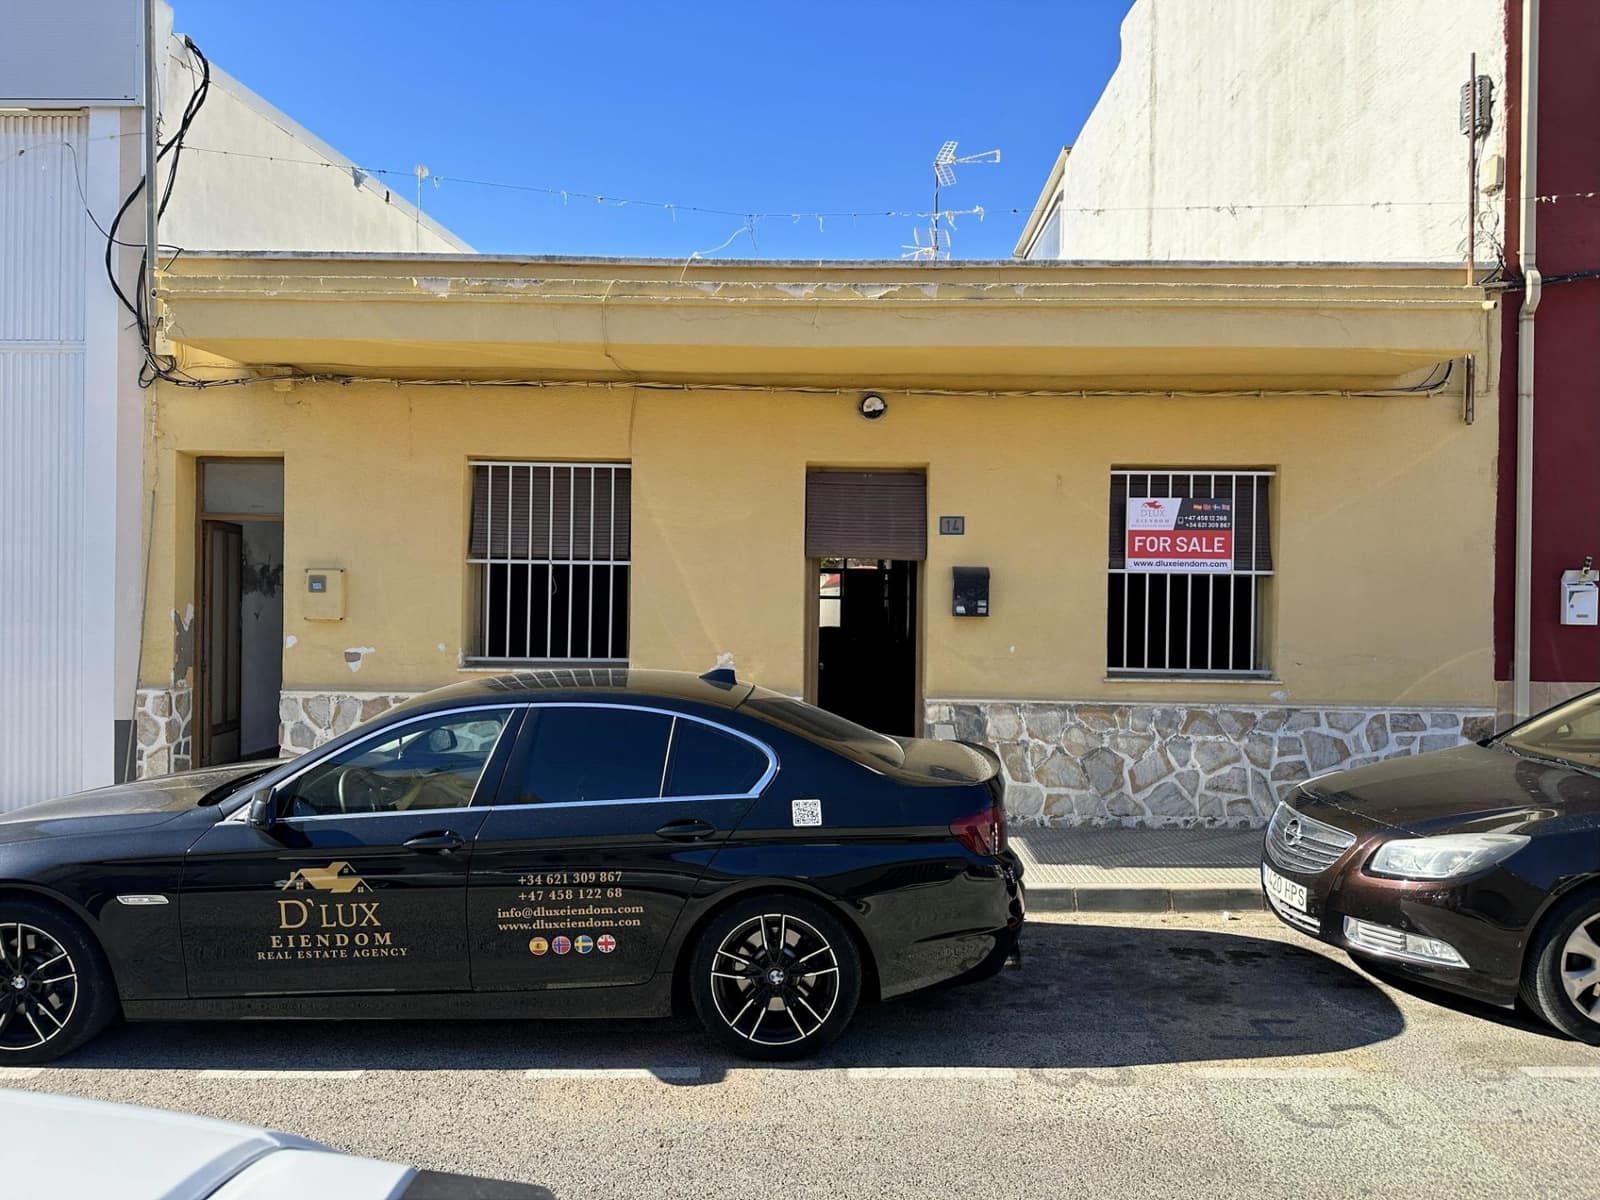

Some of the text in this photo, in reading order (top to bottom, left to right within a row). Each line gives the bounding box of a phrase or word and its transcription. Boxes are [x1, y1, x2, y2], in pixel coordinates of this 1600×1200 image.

[1134, 536, 1225, 553] FOR SALE
[1133, 560, 1228, 568] www.dluxeiendom.com
[518, 871, 622, 886] +34 621 309 867
[518, 887, 623, 902] +47 458 122 68
[1285, 880, 1305, 907] HPS
[497, 904, 644, 919] info@dluxeiendom.com
[270, 932, 392, 948] EIENDOM
[257, 947, 408, 960] REAL ESTATE AGENCY
